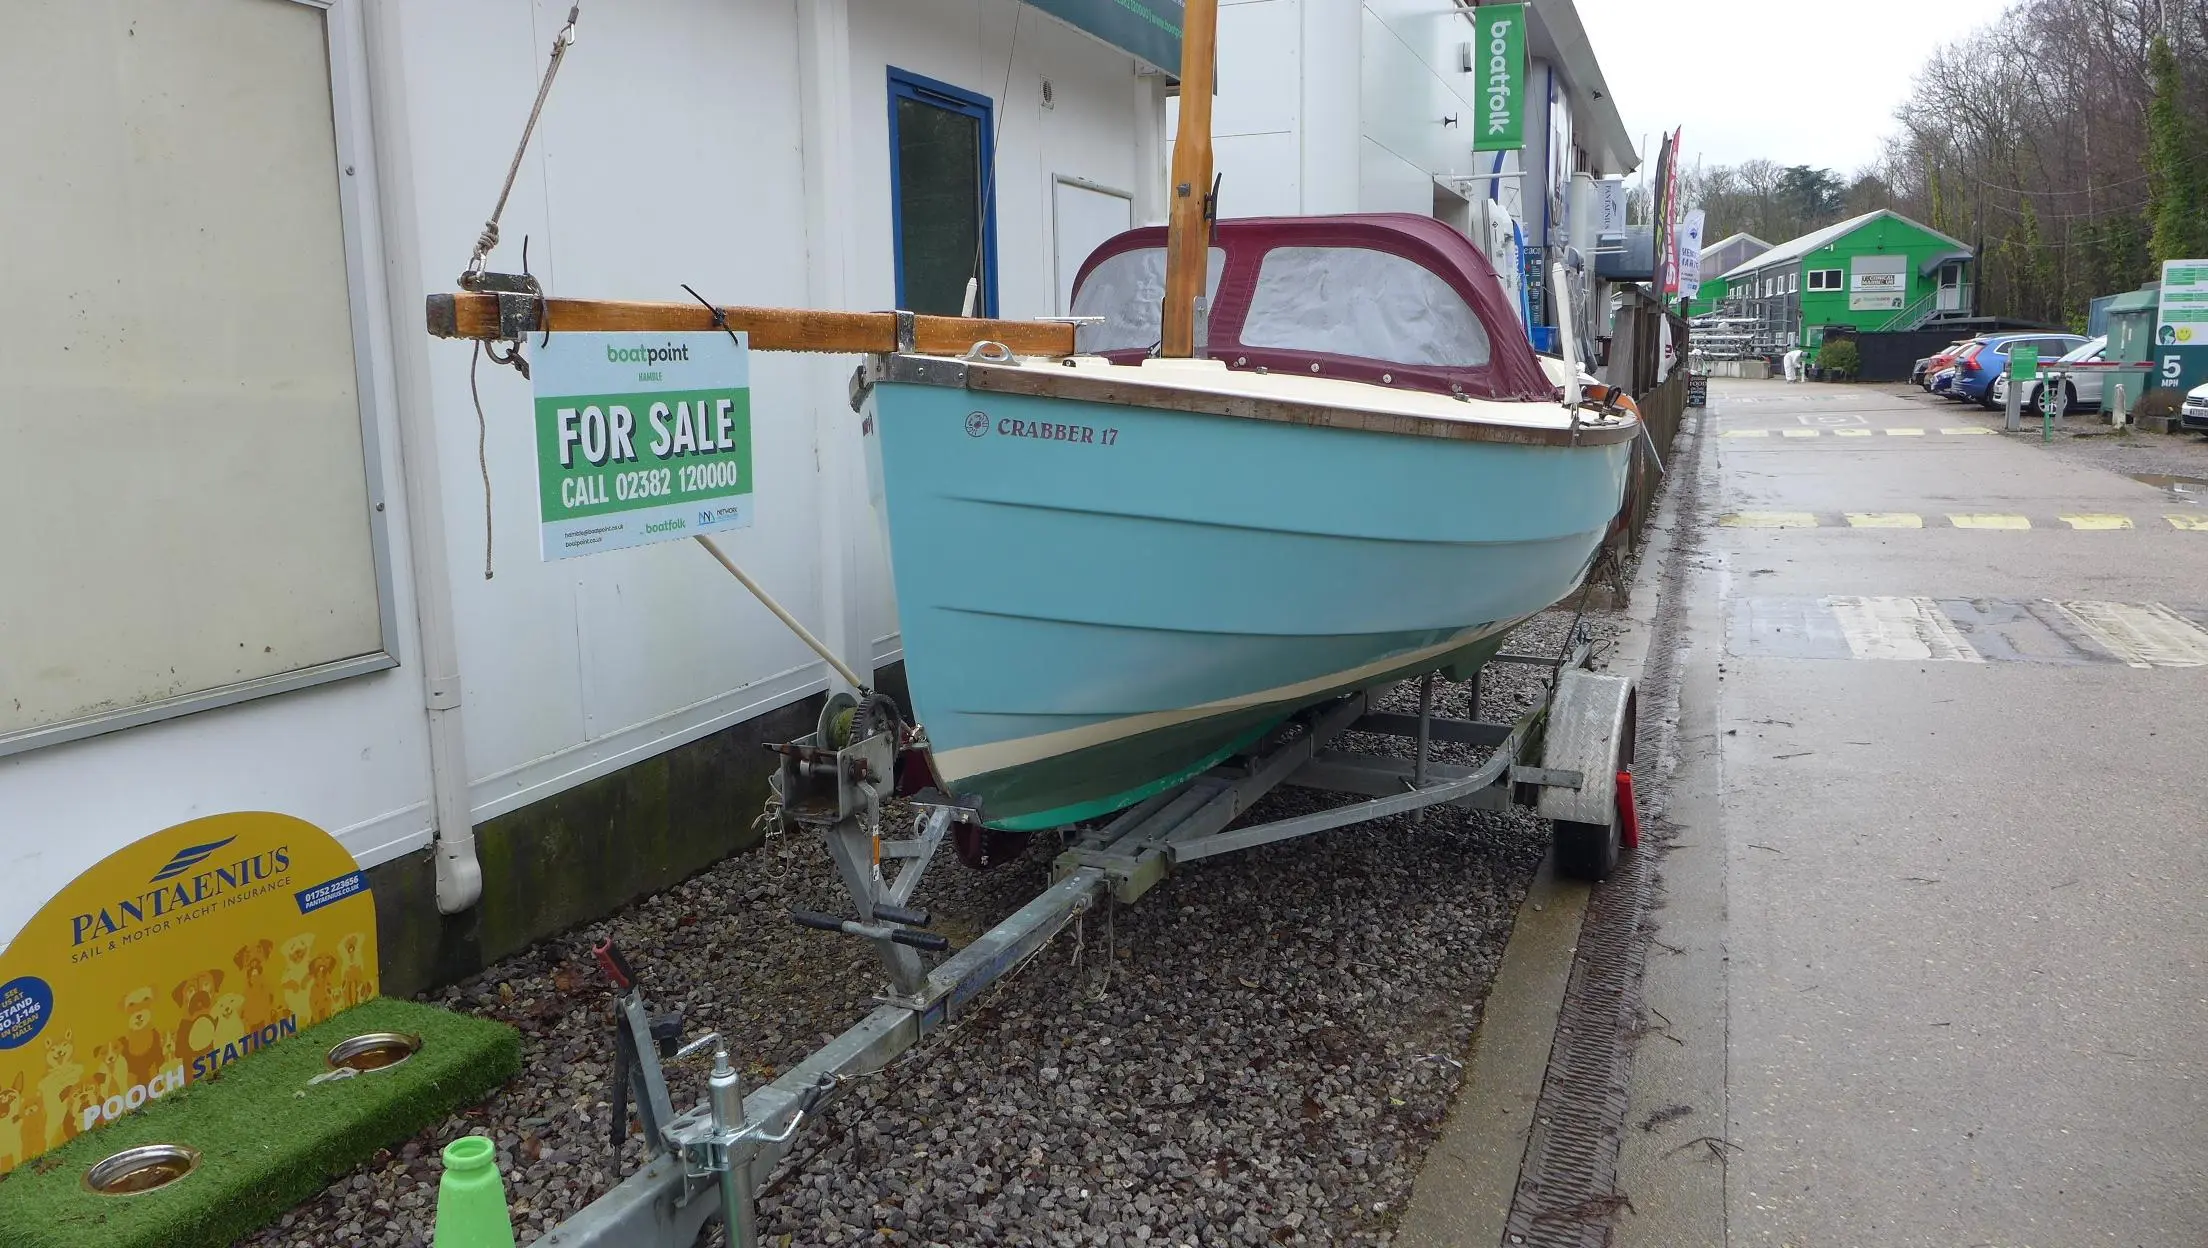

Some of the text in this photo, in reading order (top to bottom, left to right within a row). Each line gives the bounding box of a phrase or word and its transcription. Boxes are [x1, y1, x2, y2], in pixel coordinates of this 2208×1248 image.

[1488, 20, 1512, 136] boatfolk
[1604, 185, 1612, 230] PANTAENIUS
[607, 342, 689, 366] boatpoint
[2162, 355, 2181, 378] 5
[638, 371, 663, 382] HAMBLE
[2161, 379, 2179, 388] MPH
[557, 398, 736, 469] FOR SALE
[997, 418, 1118, 446] CRABBER 17
[561, 460, 737, 509] CALL 02382 120000
[645, 517, 686, 534] boatfolk
[71, 846, 289, 947] PANTAENIUS
[305, 875, 359, 902] 01752 223656
[305, 883, 360, 909] PANTAENIUS.CO.UK
[71, 876, 292, 964] SAIL & MOTOR YACHT INSURANCE
[0, 997, 33, 1021] STAND
[12, 1012, 39, 1032] OCEAN
[15, 1002, 41, 1025] J-146
[12, 1024, 33, 1040] HALL
[83, 1013, 297, 1131] POOCH STATION
